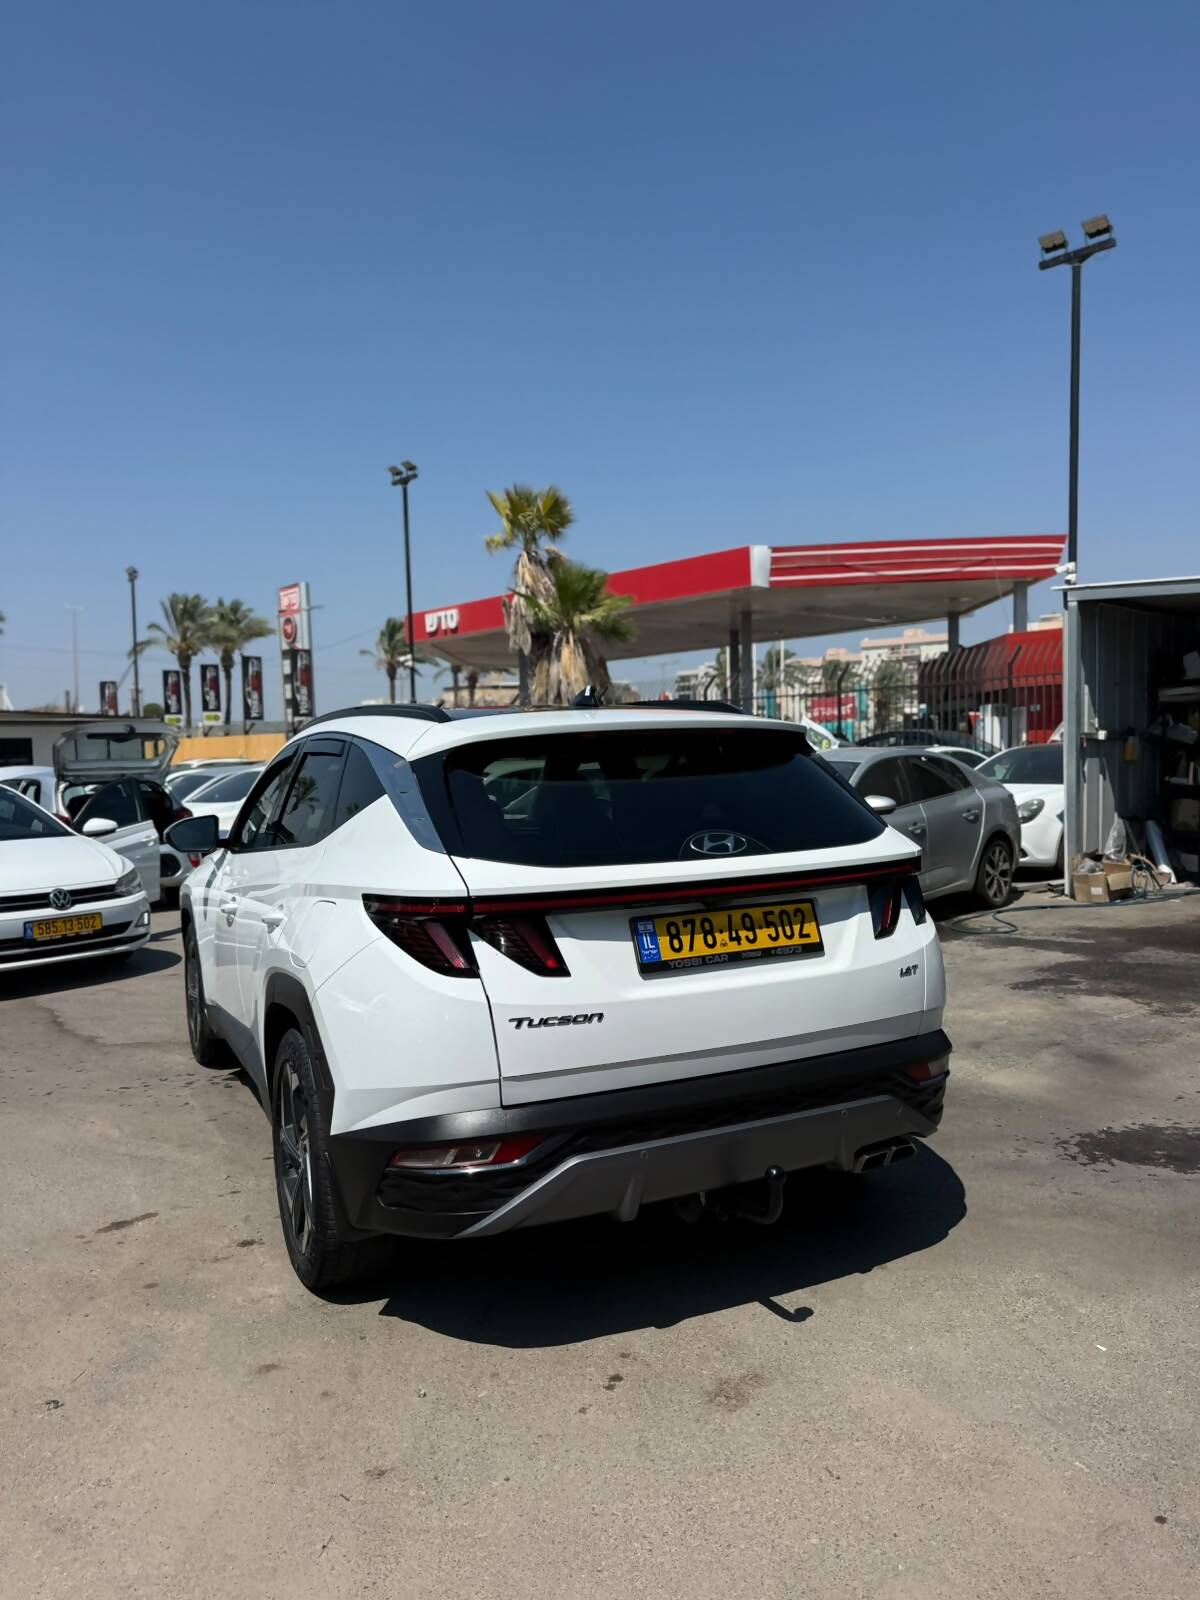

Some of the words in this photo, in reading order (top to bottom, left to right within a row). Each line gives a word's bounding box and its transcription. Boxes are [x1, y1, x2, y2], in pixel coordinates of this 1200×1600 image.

[642, 933, 656, 949] IL
[668, 957, 701, 969] YOSSI
[705, 953, 729, 963] CAR
